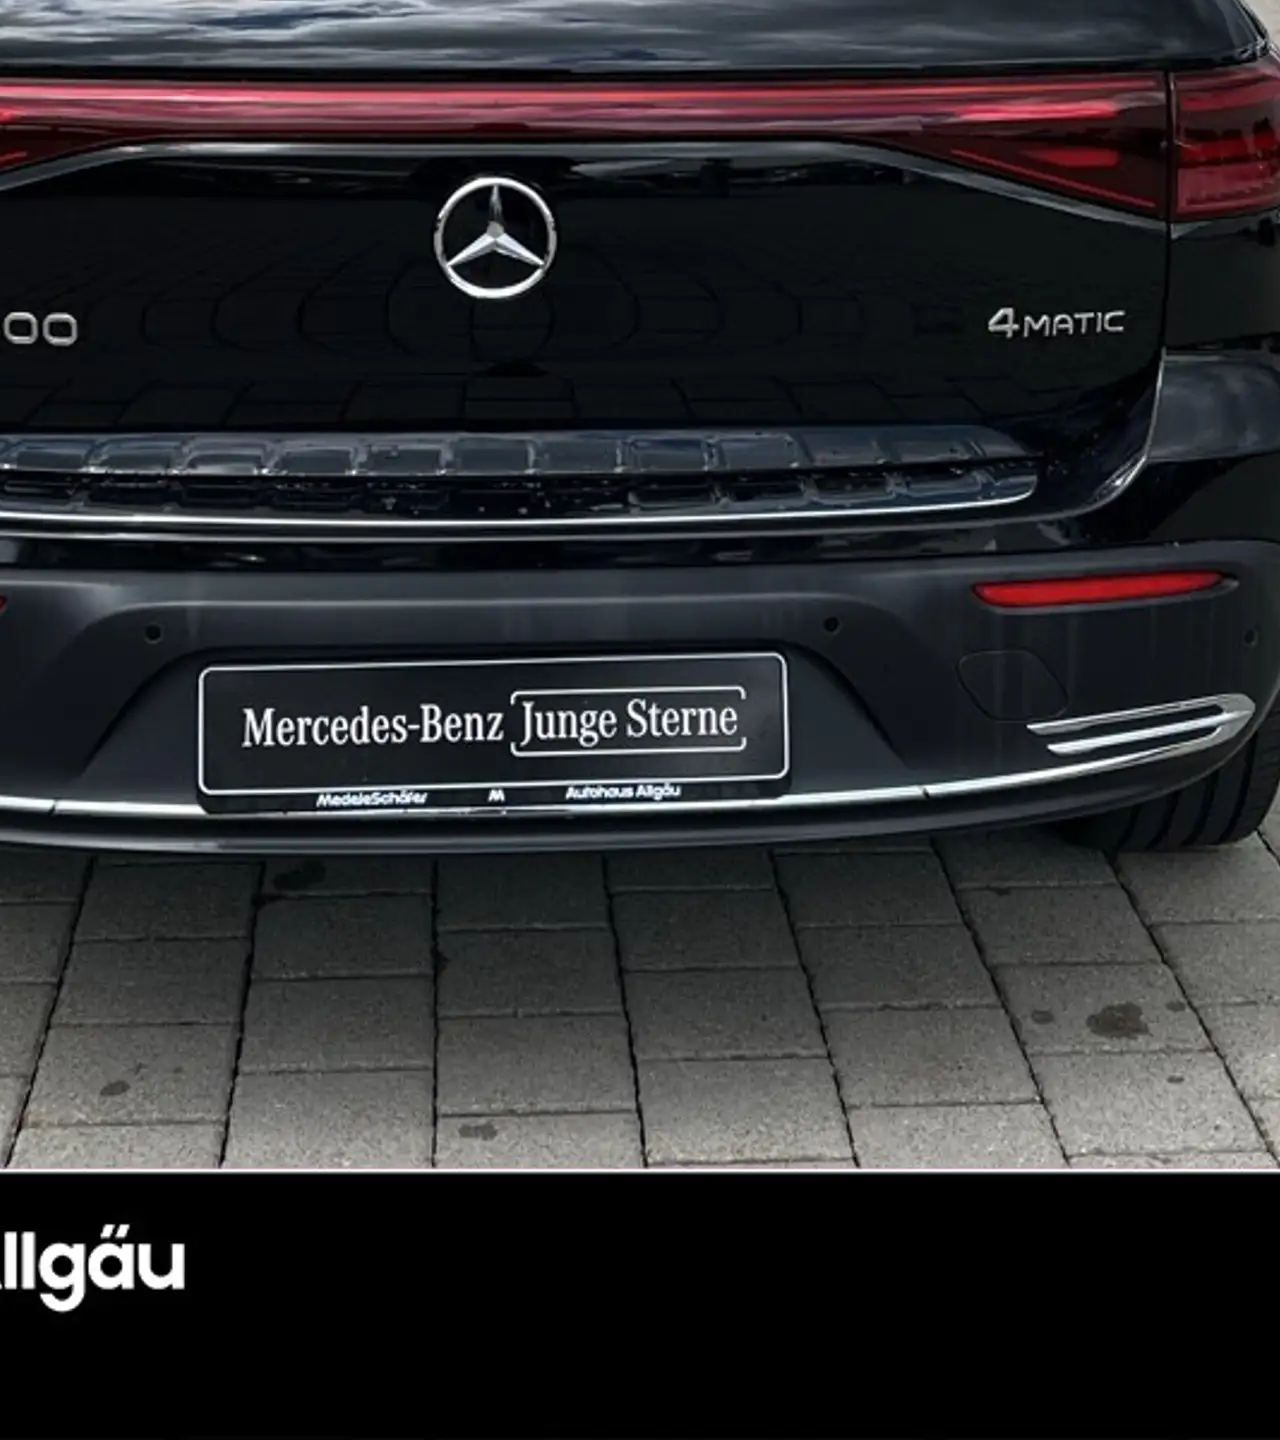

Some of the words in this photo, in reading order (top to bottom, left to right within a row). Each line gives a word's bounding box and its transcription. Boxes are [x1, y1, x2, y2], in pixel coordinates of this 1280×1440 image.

[987, 307, 1126, 338] 4MATIC
[241, 703, 504, 748] Mercedes-Benz
[519, 700, 617, 748] Junge
[626, 698, 739, 739] Sterne
[316, 790, 427, 807] MedeleSchäfer
[565, 786, 634, 800] Autohaus
[635, 783, 682, 802] Allgäu
